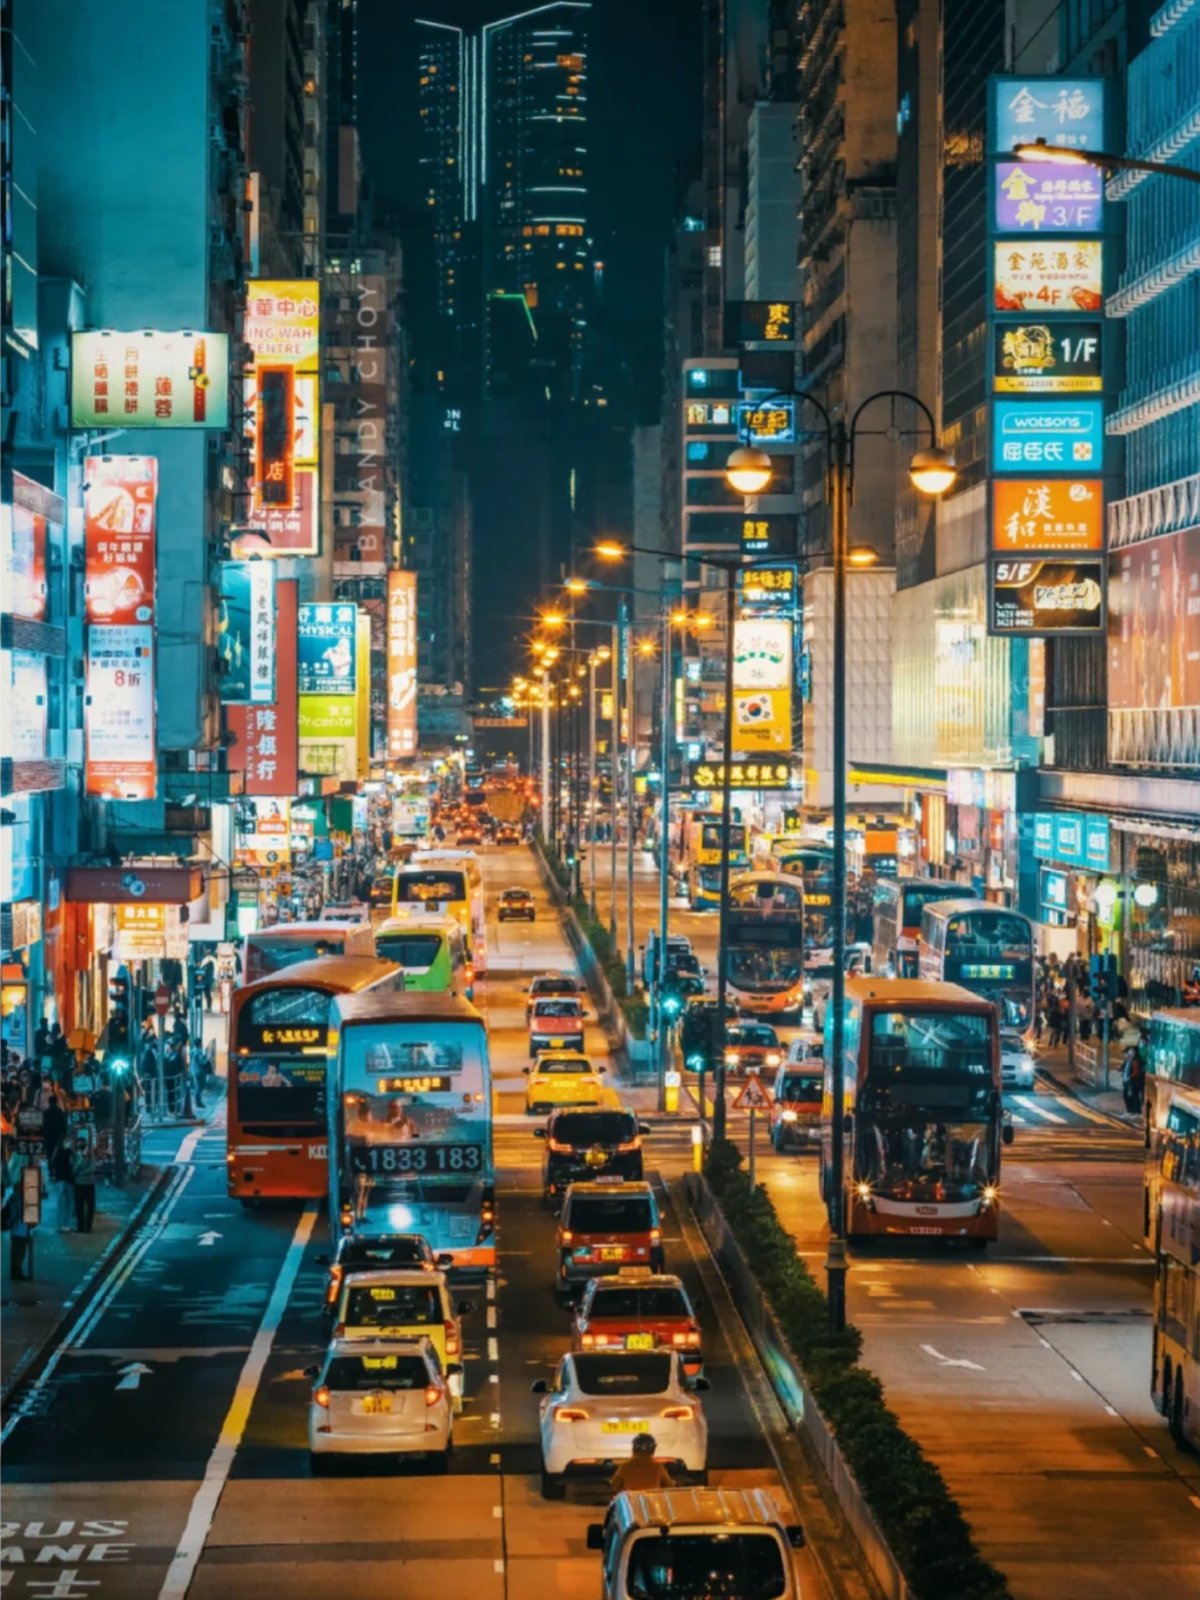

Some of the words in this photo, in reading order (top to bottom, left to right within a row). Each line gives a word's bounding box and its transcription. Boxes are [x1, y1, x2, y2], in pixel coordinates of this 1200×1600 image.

[1053, 206, 1092, 227] 3/F
[279, 327, 312, 338] WAH
[252, 343, 301, 354] ENTRE
[1061, 338, 1097, 363] 1/F
[1014, 416, 1080, 429] watsons
[1003, 442, 1063, 462] 屈臣氏
[997, 563, 1031, 580] 5/F
[18, 1141, 44, 1154] S12
[369, 1149, 427, 1170] 1833
[436, 1147, 479, 1169] 183
